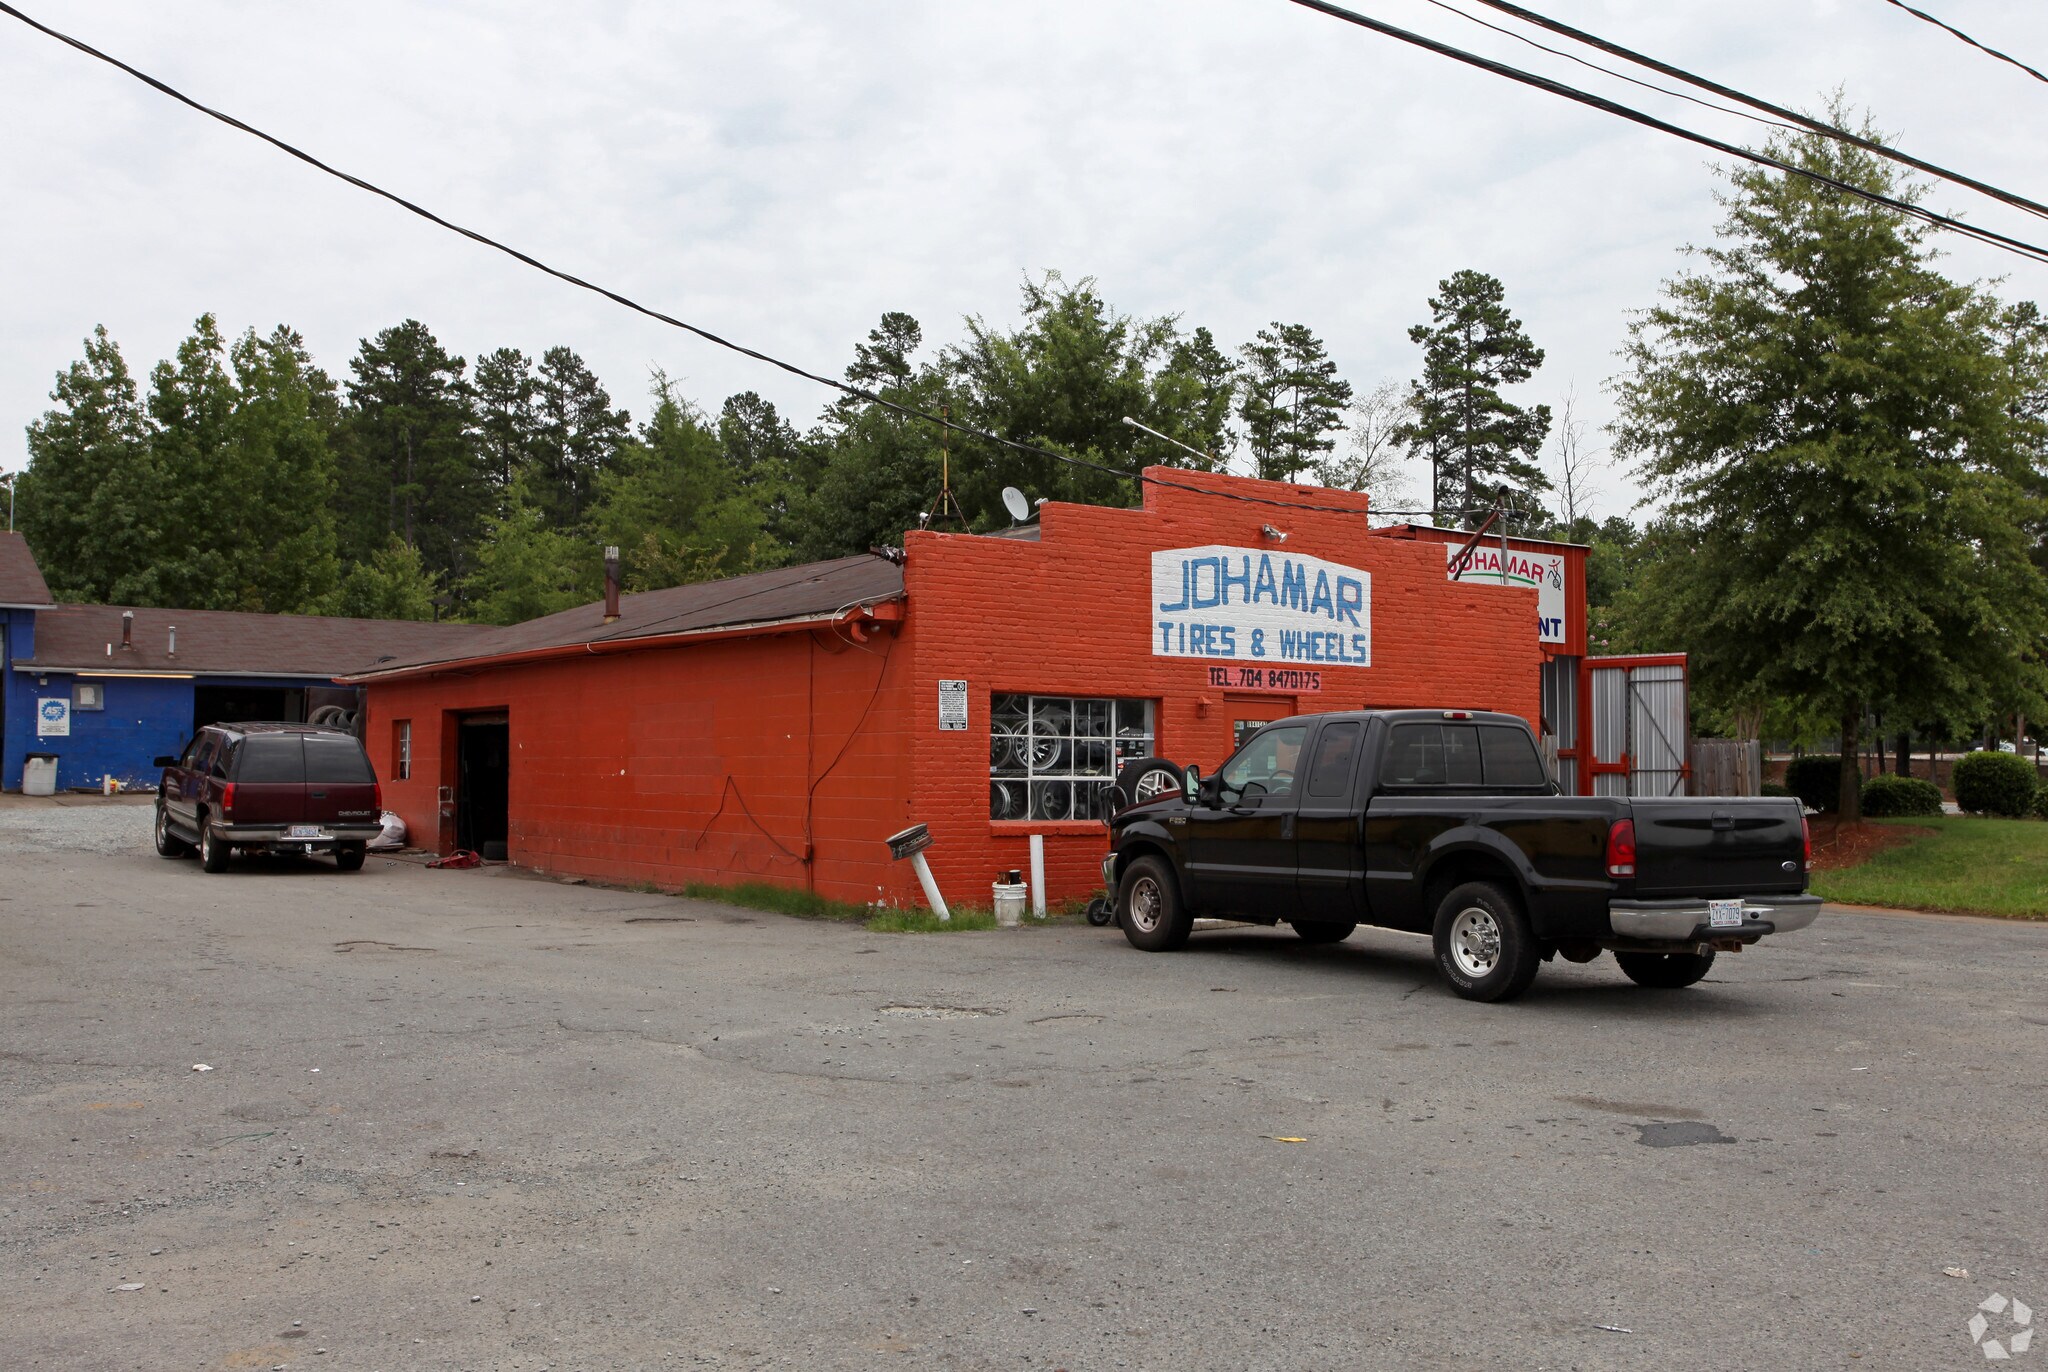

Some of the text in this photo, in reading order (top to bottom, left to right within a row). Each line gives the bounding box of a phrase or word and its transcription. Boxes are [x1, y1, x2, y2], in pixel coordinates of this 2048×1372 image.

[1448, 552, 1544, 583] JOHAMAR
[1160, 553, 1363, 627] JOHAMAR
[1158, 621, 1366, 663] TIRES & WHEELS
[1539, 617, 1562, 637] NT
[1268, 670, 1320, 689] 8470175
